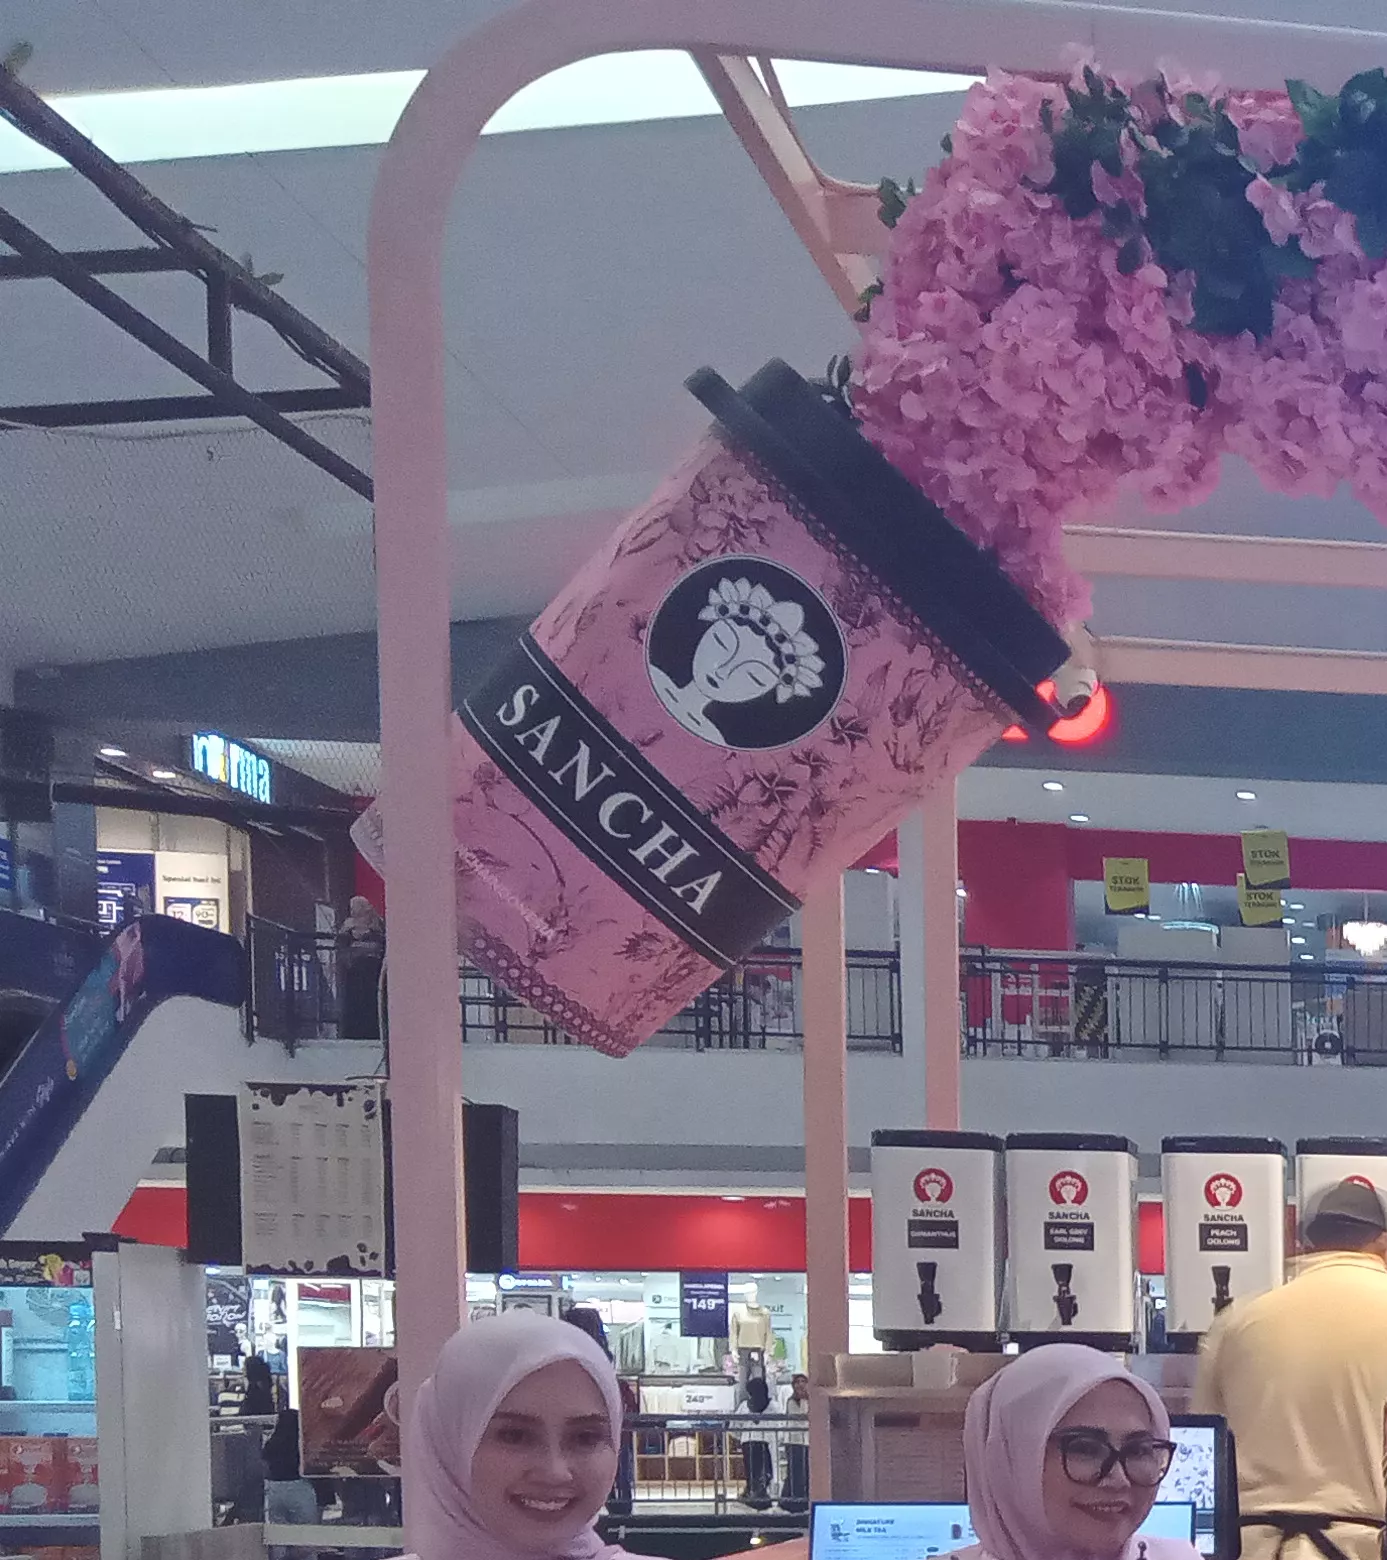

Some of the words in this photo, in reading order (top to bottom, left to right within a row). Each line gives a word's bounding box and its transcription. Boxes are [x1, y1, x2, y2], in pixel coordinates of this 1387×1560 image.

[497, 684, 723, 916] SANCHA
[1111, 875, 1140, 885] STOK
[911, 1208, 955, 1219] SANCHA
[1047, 1211, 1091, 1221] SANCHA
[1203, 1213, 1245, 1223] SANCHA
[1210, 1228, 1237, 1237] PEACH
